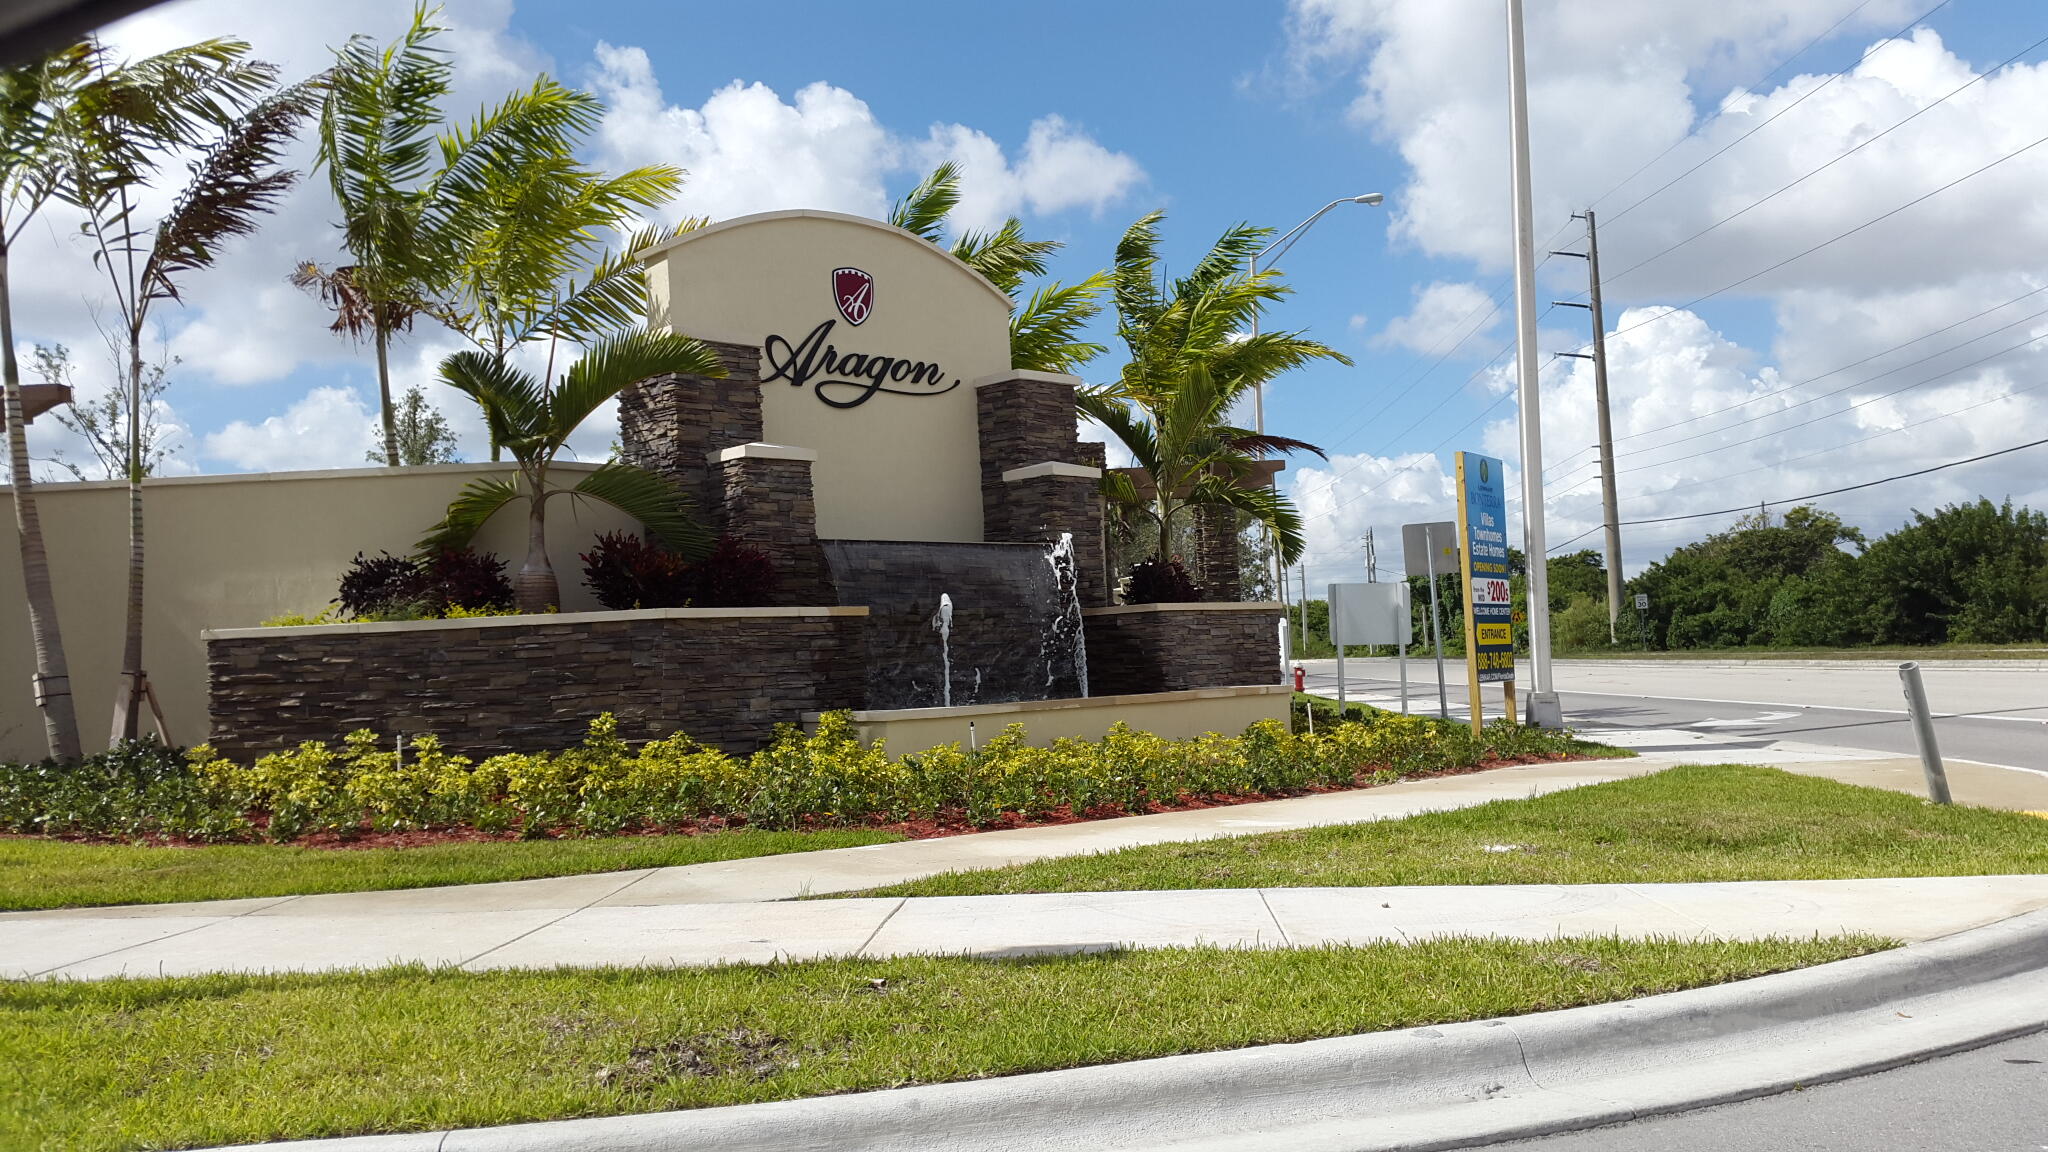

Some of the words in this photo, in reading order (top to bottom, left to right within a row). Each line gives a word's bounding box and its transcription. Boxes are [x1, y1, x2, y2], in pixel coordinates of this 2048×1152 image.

[761, 319, 960, 409] Aragon
[1480, 512, 1495, 527] Villas
[1473, 526, 1503, 543] Townhomes
[1472, 541, 1488, 556] Estate
[1488, 543, 1505, 558] Homes
[1473, 561, 1492, 573] OPENING
[1472, 606, 1490, 615] WELCOME
[1490, 607, 1499, 616] HOME
[1499, 607, 1510, 616] CENTER
[1481, 628, 1507, 640] ENTRANCE
